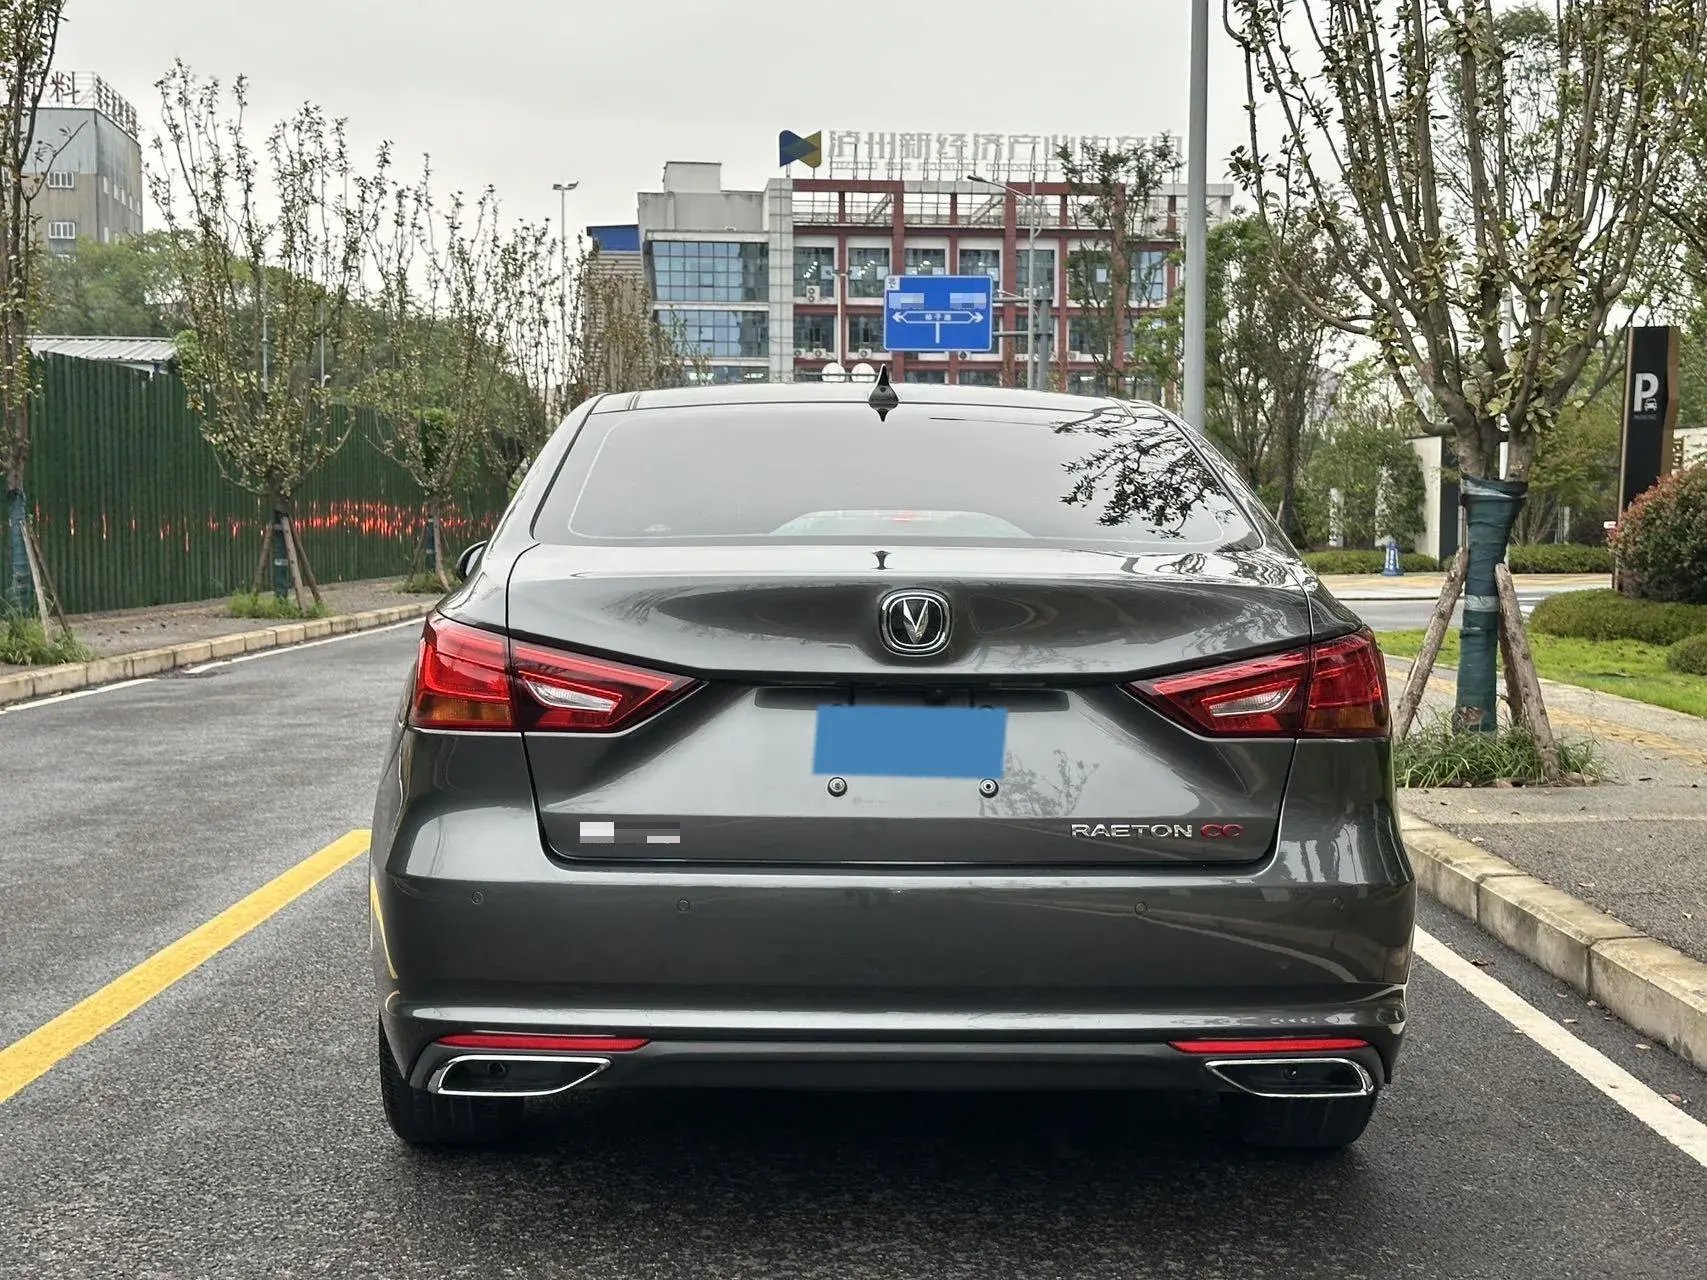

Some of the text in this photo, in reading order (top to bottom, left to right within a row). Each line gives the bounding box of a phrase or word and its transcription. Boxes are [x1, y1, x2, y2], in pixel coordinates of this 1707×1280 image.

[1634, 373, 1659, 412] P
[1071, 824, 1243, 839] RAETON CC
